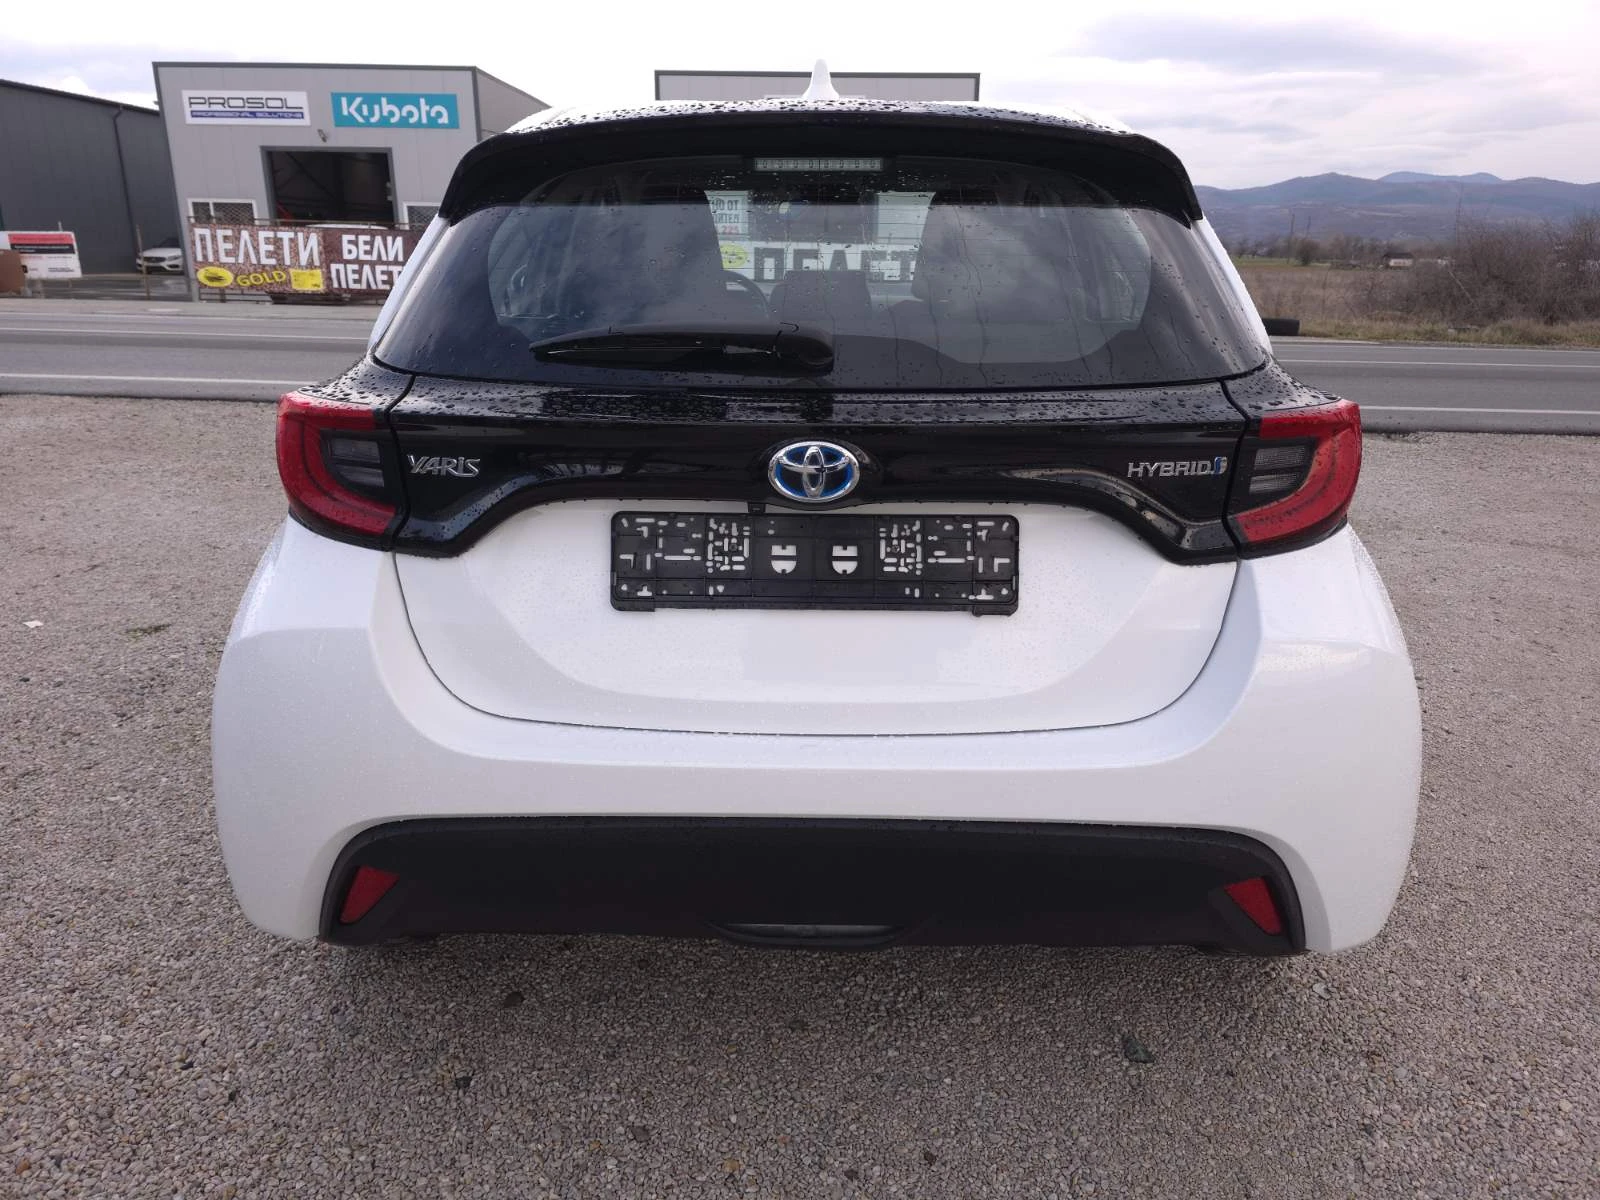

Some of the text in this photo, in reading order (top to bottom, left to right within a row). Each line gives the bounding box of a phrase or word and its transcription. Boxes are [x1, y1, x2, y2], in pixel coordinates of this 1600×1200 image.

[188, 96, 304, 110] PROSOL
[341, 96, 449, 124] Kubota
[193, 227, 320, 266] ПЕЛЕТИ
[342, 234, 404, 262] БЕЛИ
[236, 270, 286, 287] GOLD
[406, 454, 481, 478] YARIS
[1127, 460, 1212, 478] HYBRID
